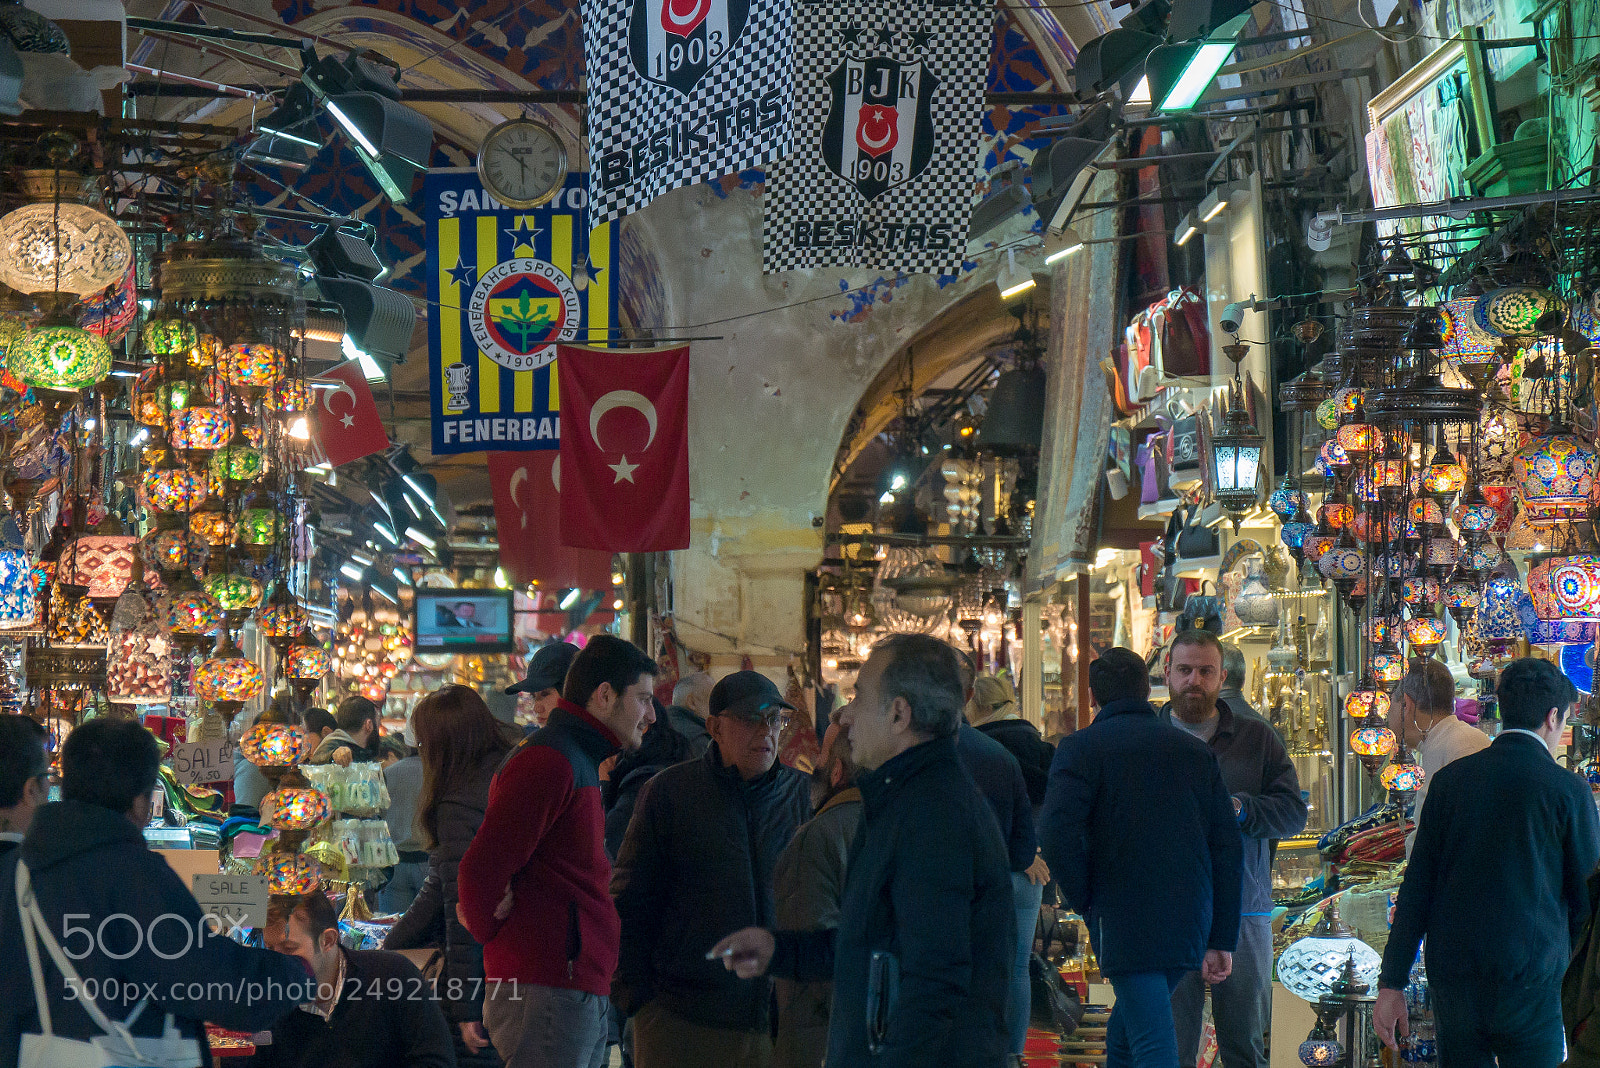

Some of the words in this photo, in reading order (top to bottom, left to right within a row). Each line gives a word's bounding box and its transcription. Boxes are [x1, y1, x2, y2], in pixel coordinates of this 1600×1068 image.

[655, 30, 724, 78] 1903
[847, 67, 917, 99] BJK
[850, 159, 904, 181] 1903
[524, 260, 564, 286] SPOR
[558, 286, 579, 341] KULÜB
[506, 354, 543, 367] 1907
[443, 417, 560, 444] FENERBA
[176, 746, 230, 773] SALE
[209, 881, 250, 896] SALE
